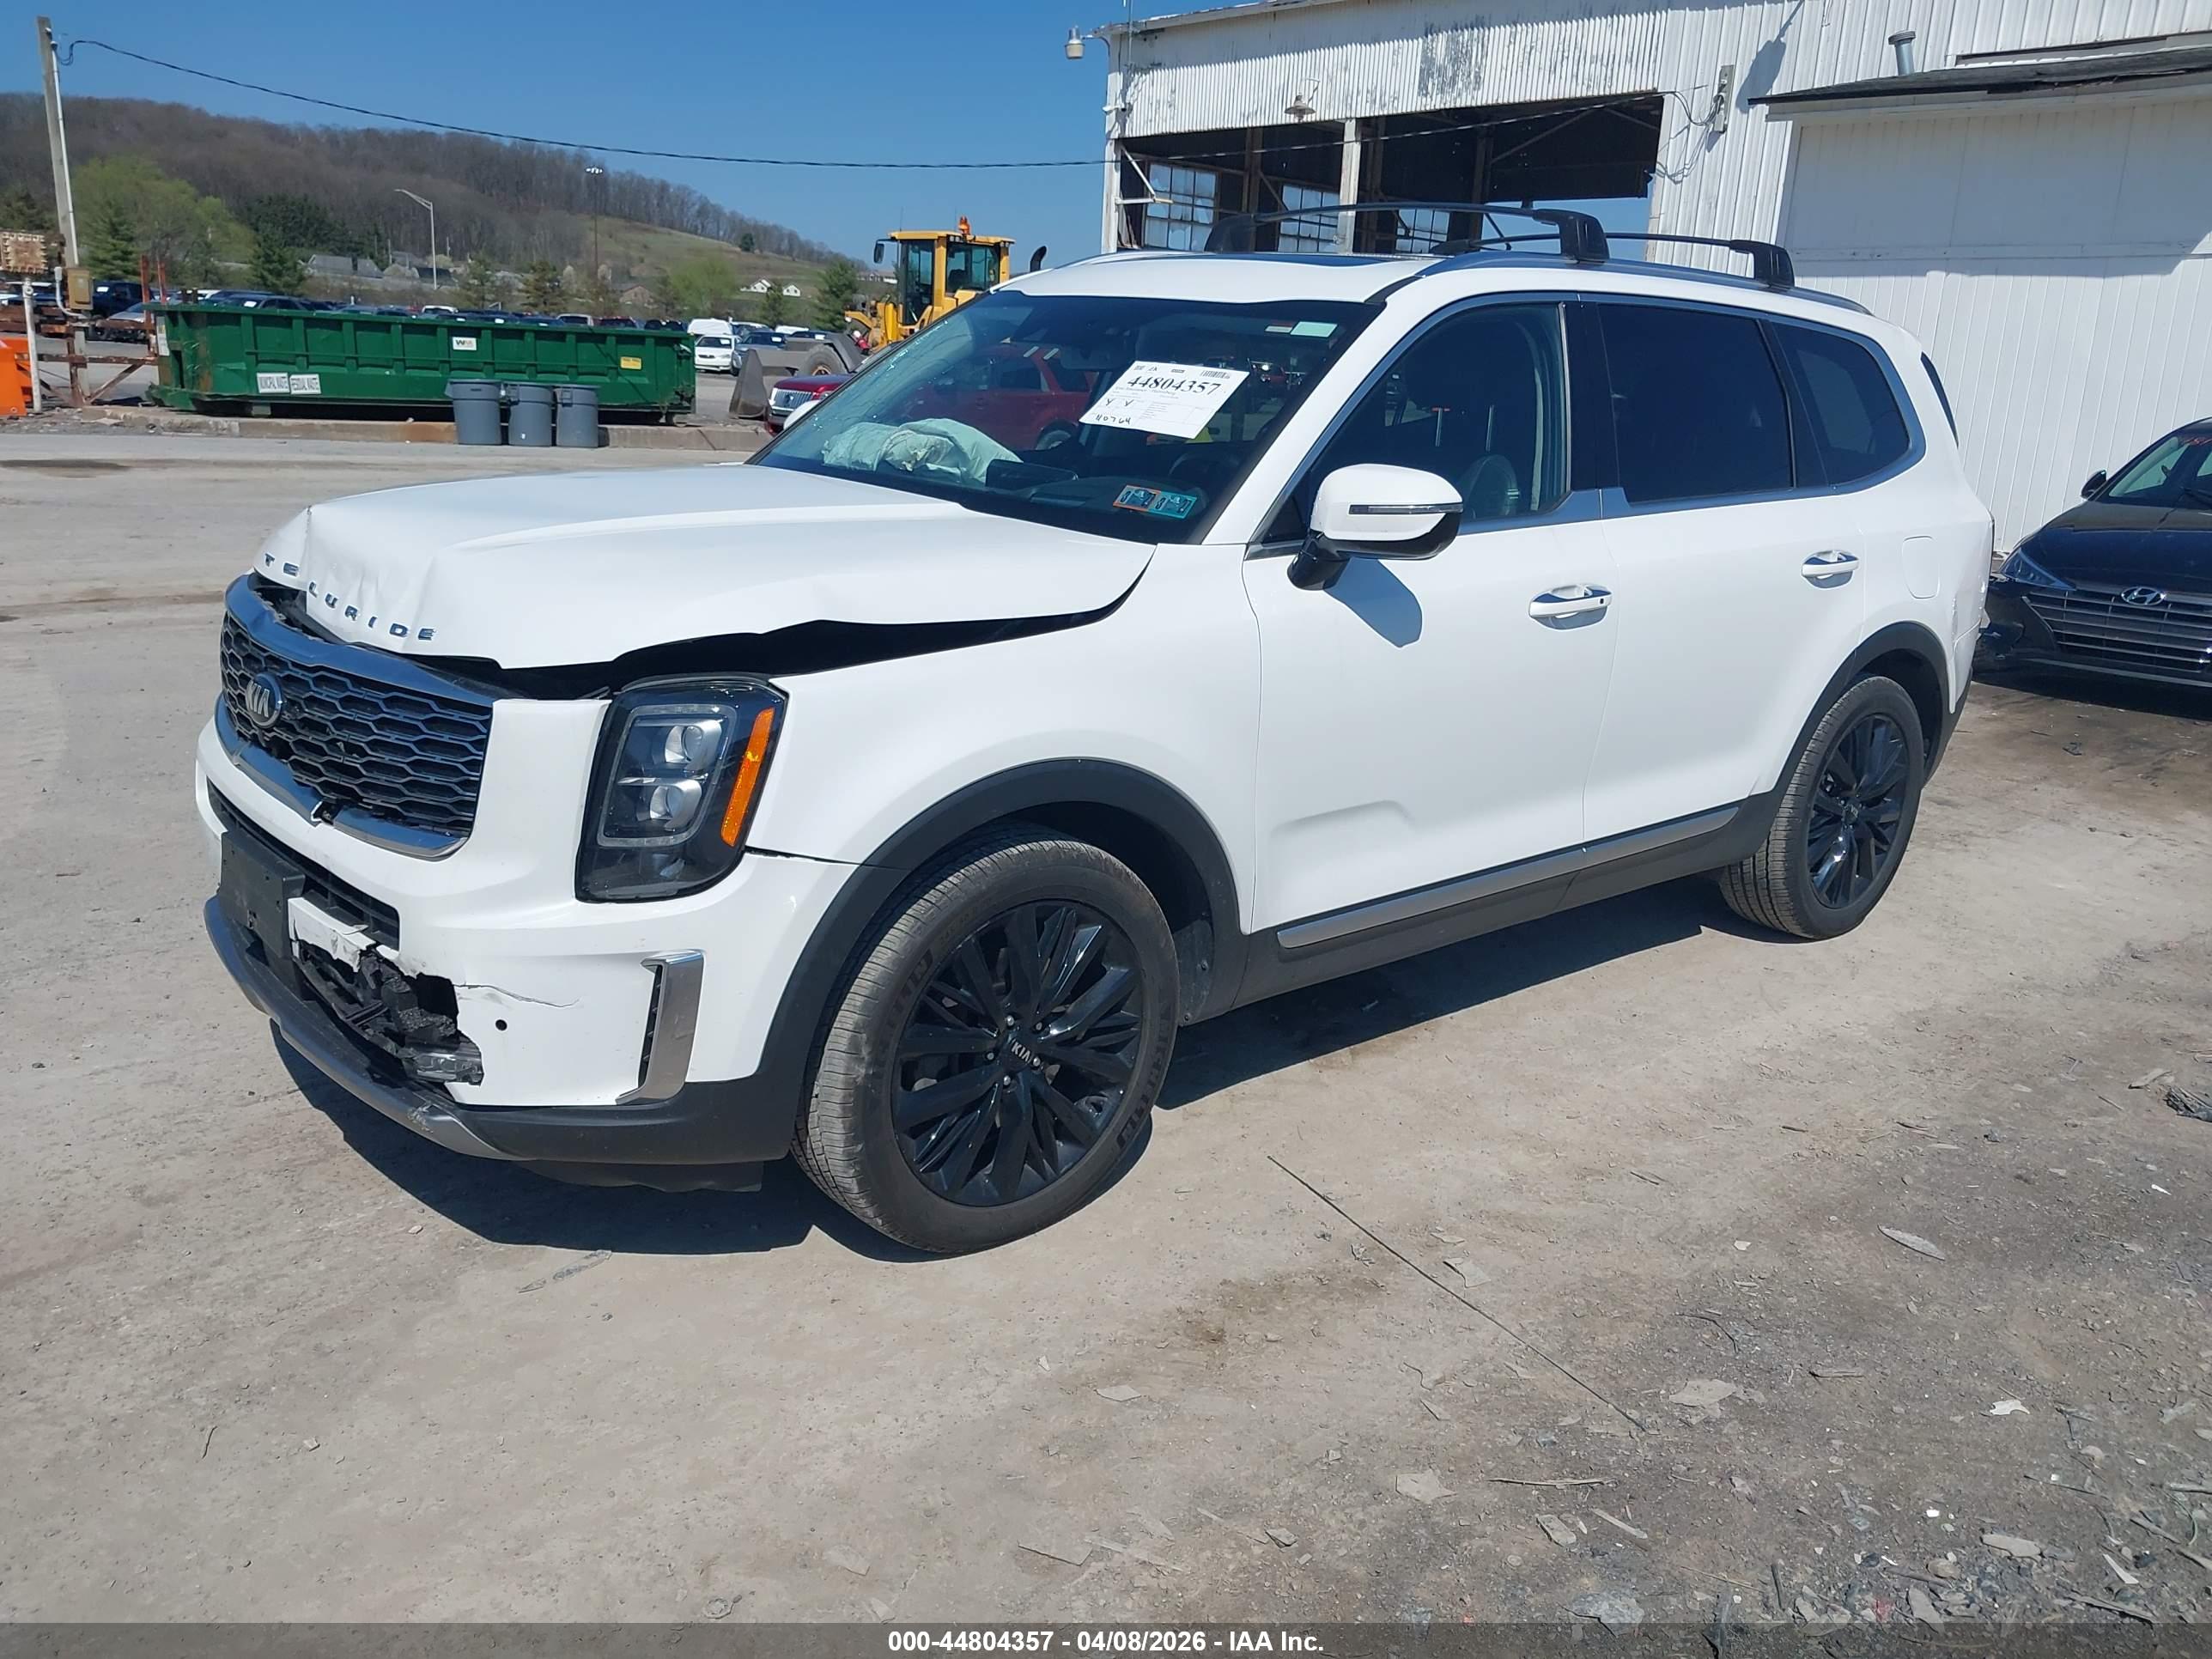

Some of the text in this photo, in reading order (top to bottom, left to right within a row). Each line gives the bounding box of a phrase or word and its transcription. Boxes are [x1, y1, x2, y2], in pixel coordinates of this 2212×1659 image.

[1127, 375, 1222, 395] 44804357
[246, 679, 270, 718] KIA
[1012, 1042, 1030, 1062] KIA
